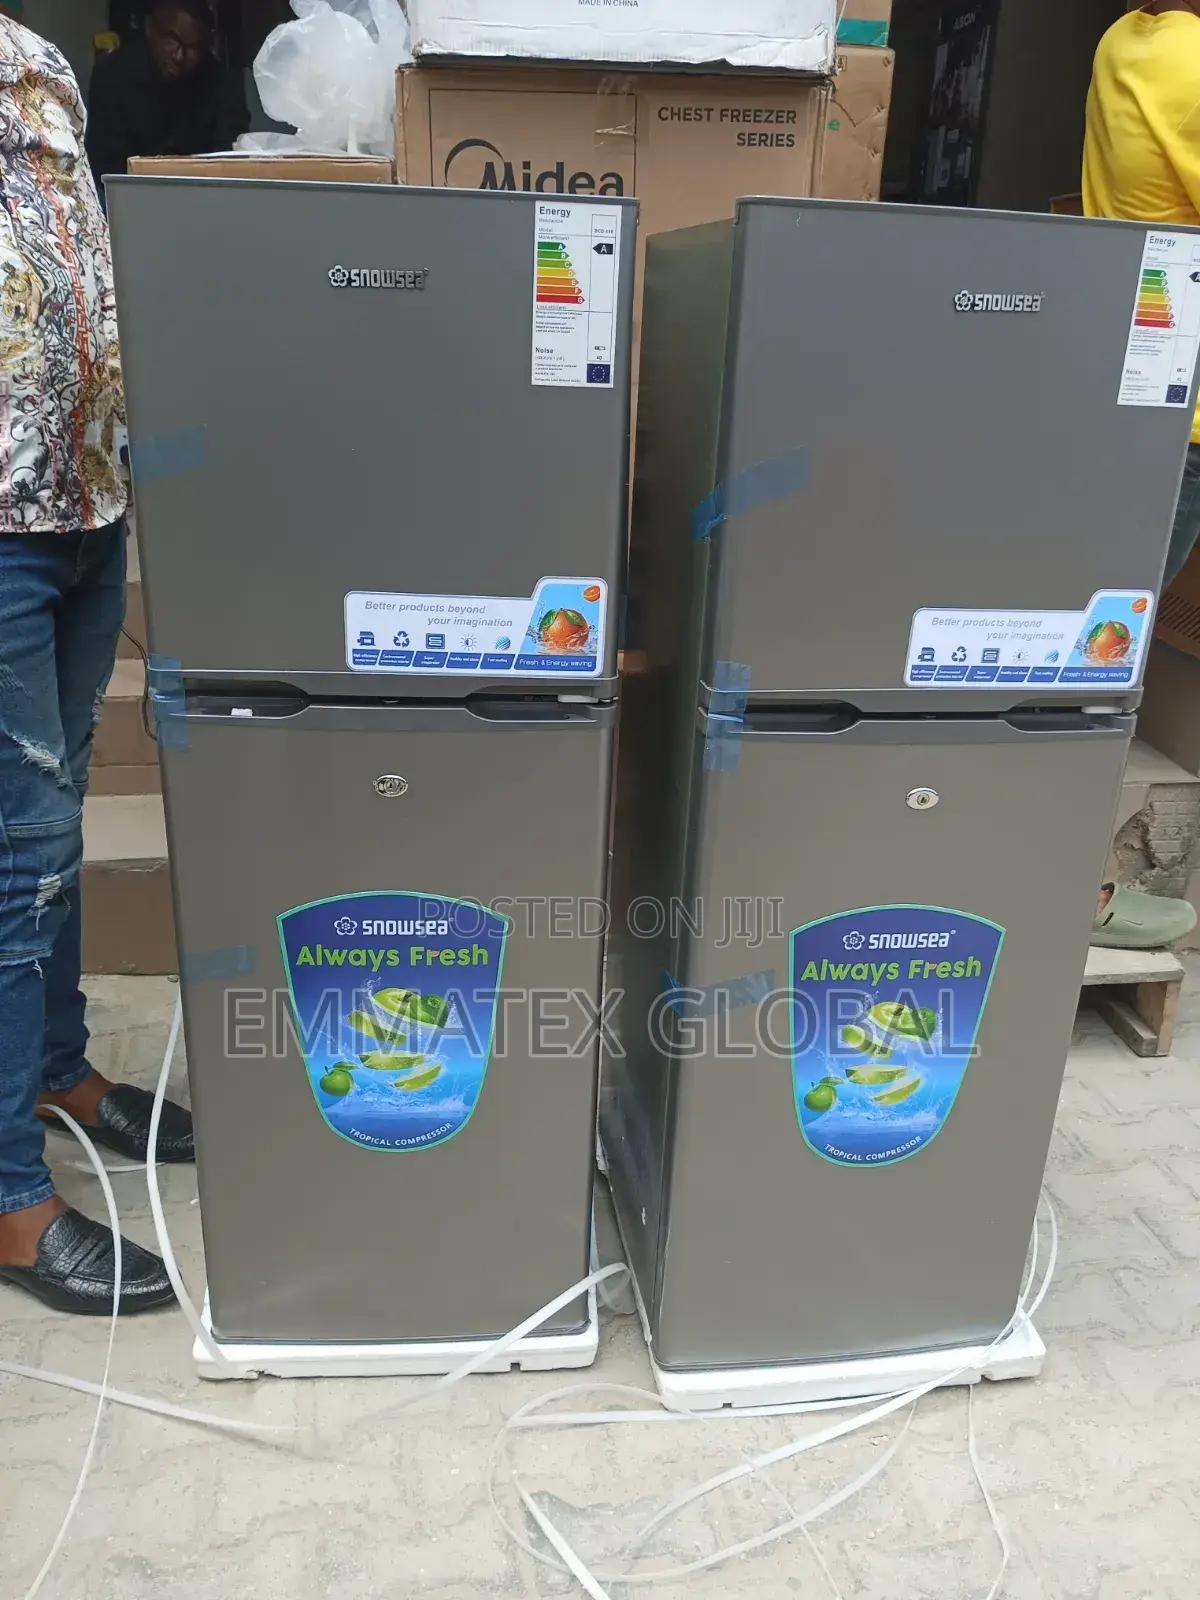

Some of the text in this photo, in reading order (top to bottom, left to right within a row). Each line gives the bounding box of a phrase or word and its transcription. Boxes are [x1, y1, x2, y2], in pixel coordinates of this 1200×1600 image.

[612, 0, 639, 8] CHINA
[657, 106, 797, 125] CHEST FREEZER
[736, 132, 796, 148] SERIES
[478, 161, 624, 197] Midea
[539, 206, 571, 218] Energy
[1149, 235, 1176, 247] Energy
[600, 245, 607, 253] A
[365, 601, 486, 615] Better products beyond
[427, 616, 513, 628] your imagination
[931, 617, 1042, 629] Better products beyond
[986, 631, 1065, 641] your imagination
[546, 659, 569, 667] Energy
[570, 660, 592, 668] saving
[296, 943, 489, 972] Always Fresh
[801, 955, 982, 986] Always Fresh
[349, 1122, 453, 1146] TROPICAL COMPRESSOR
[824, 1135, 922, 1161] TROPICAL COMPRESSOR
